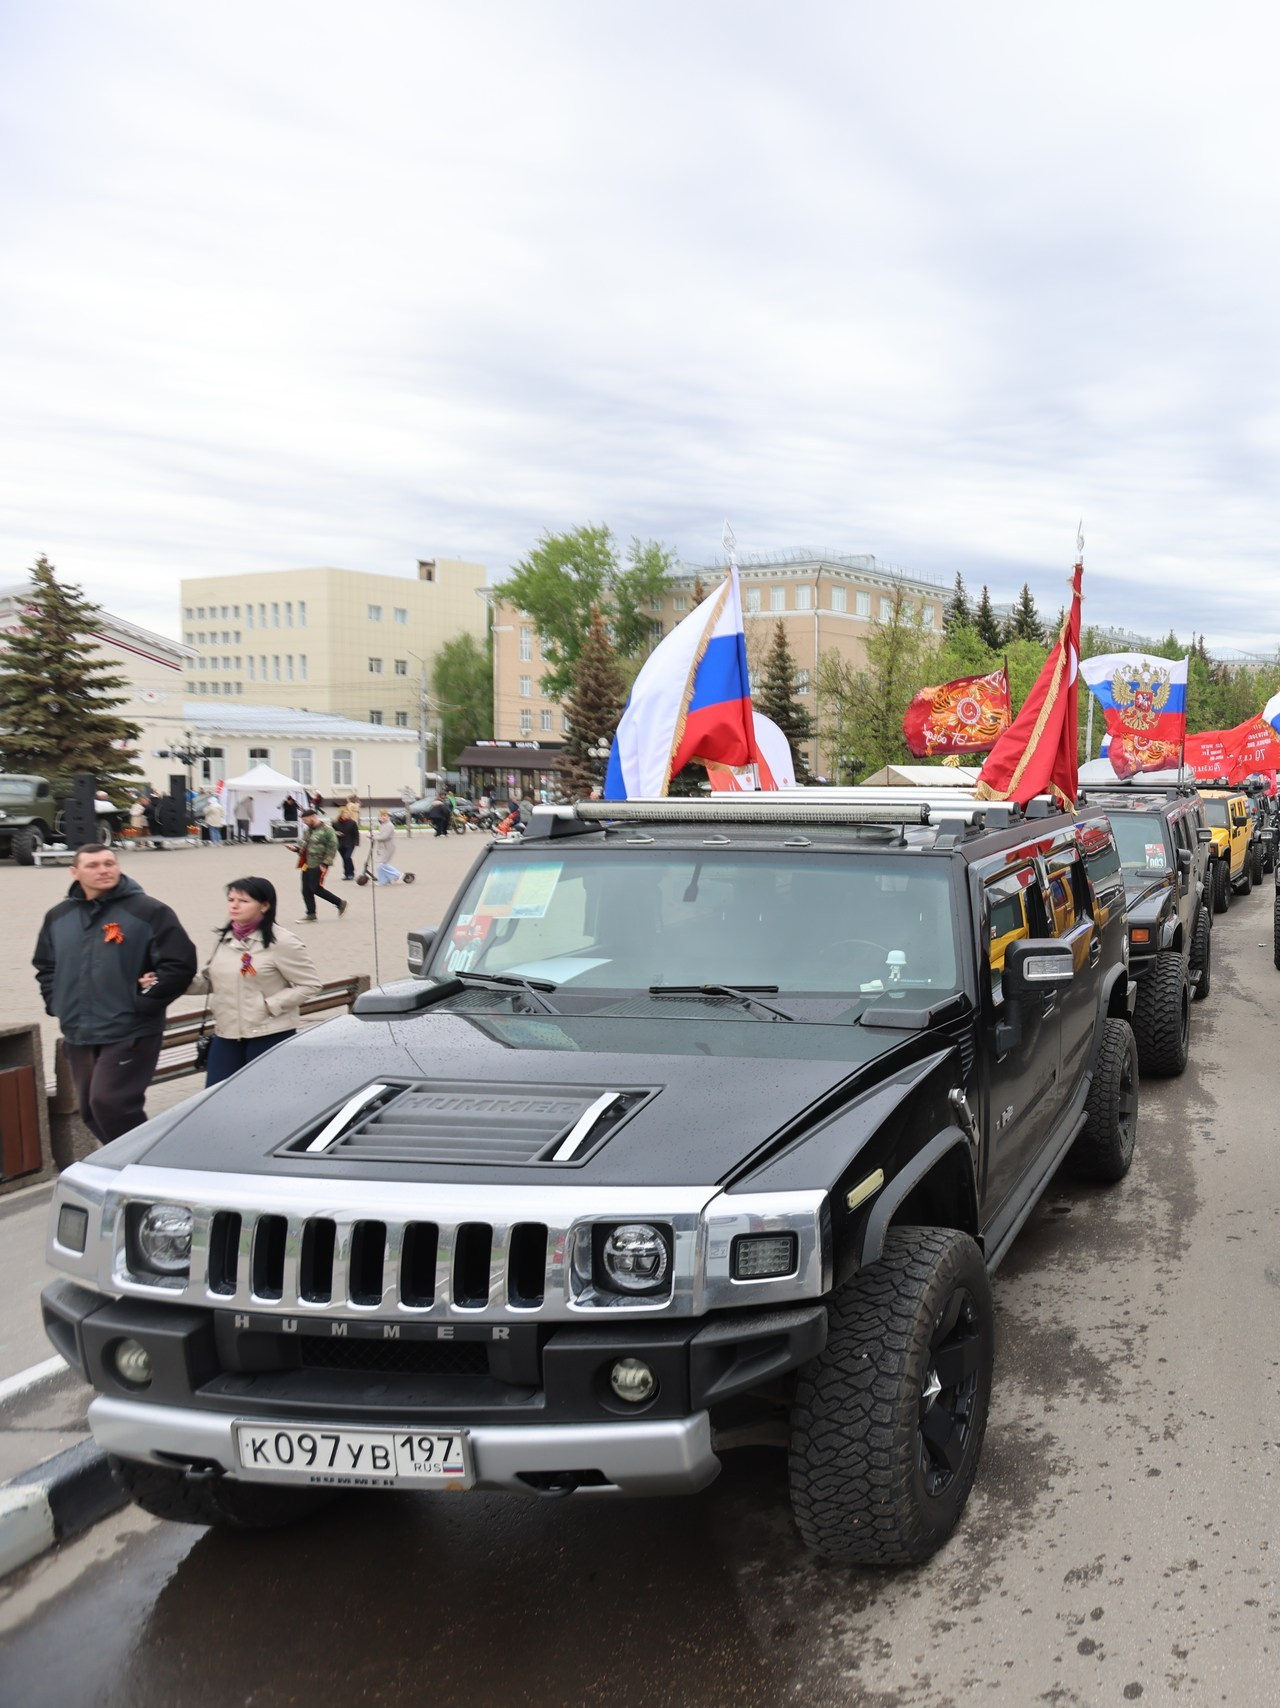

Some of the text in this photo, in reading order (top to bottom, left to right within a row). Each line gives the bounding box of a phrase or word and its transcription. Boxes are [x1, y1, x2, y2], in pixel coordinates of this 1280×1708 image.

[234, 1314, 510, 1340] HUMMER
[400, 1435, 454, 1462] 197
[414, 1462, 442, 1473] RUS
